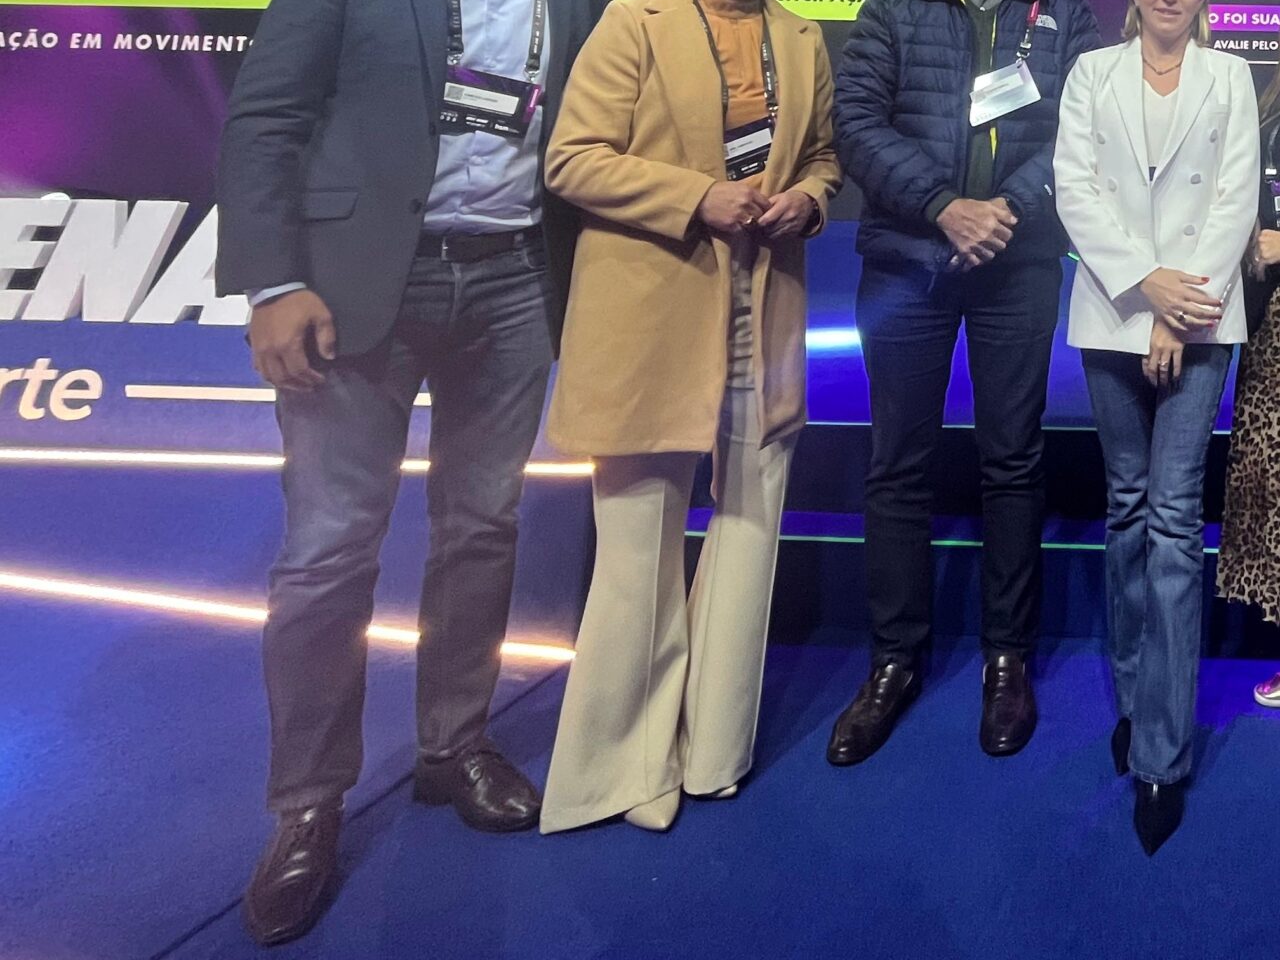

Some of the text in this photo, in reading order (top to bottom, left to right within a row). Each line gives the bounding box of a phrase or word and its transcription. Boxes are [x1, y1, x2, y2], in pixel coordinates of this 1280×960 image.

[1223, 13, 1247, 25] FOI
[1251, 14, 1280, 26] SUA
[69, 32, 102, 49] EM
[113, 33, 253, 52] MOVIMENT
[1213, 39, 1279, 51] AVALIE PELO
